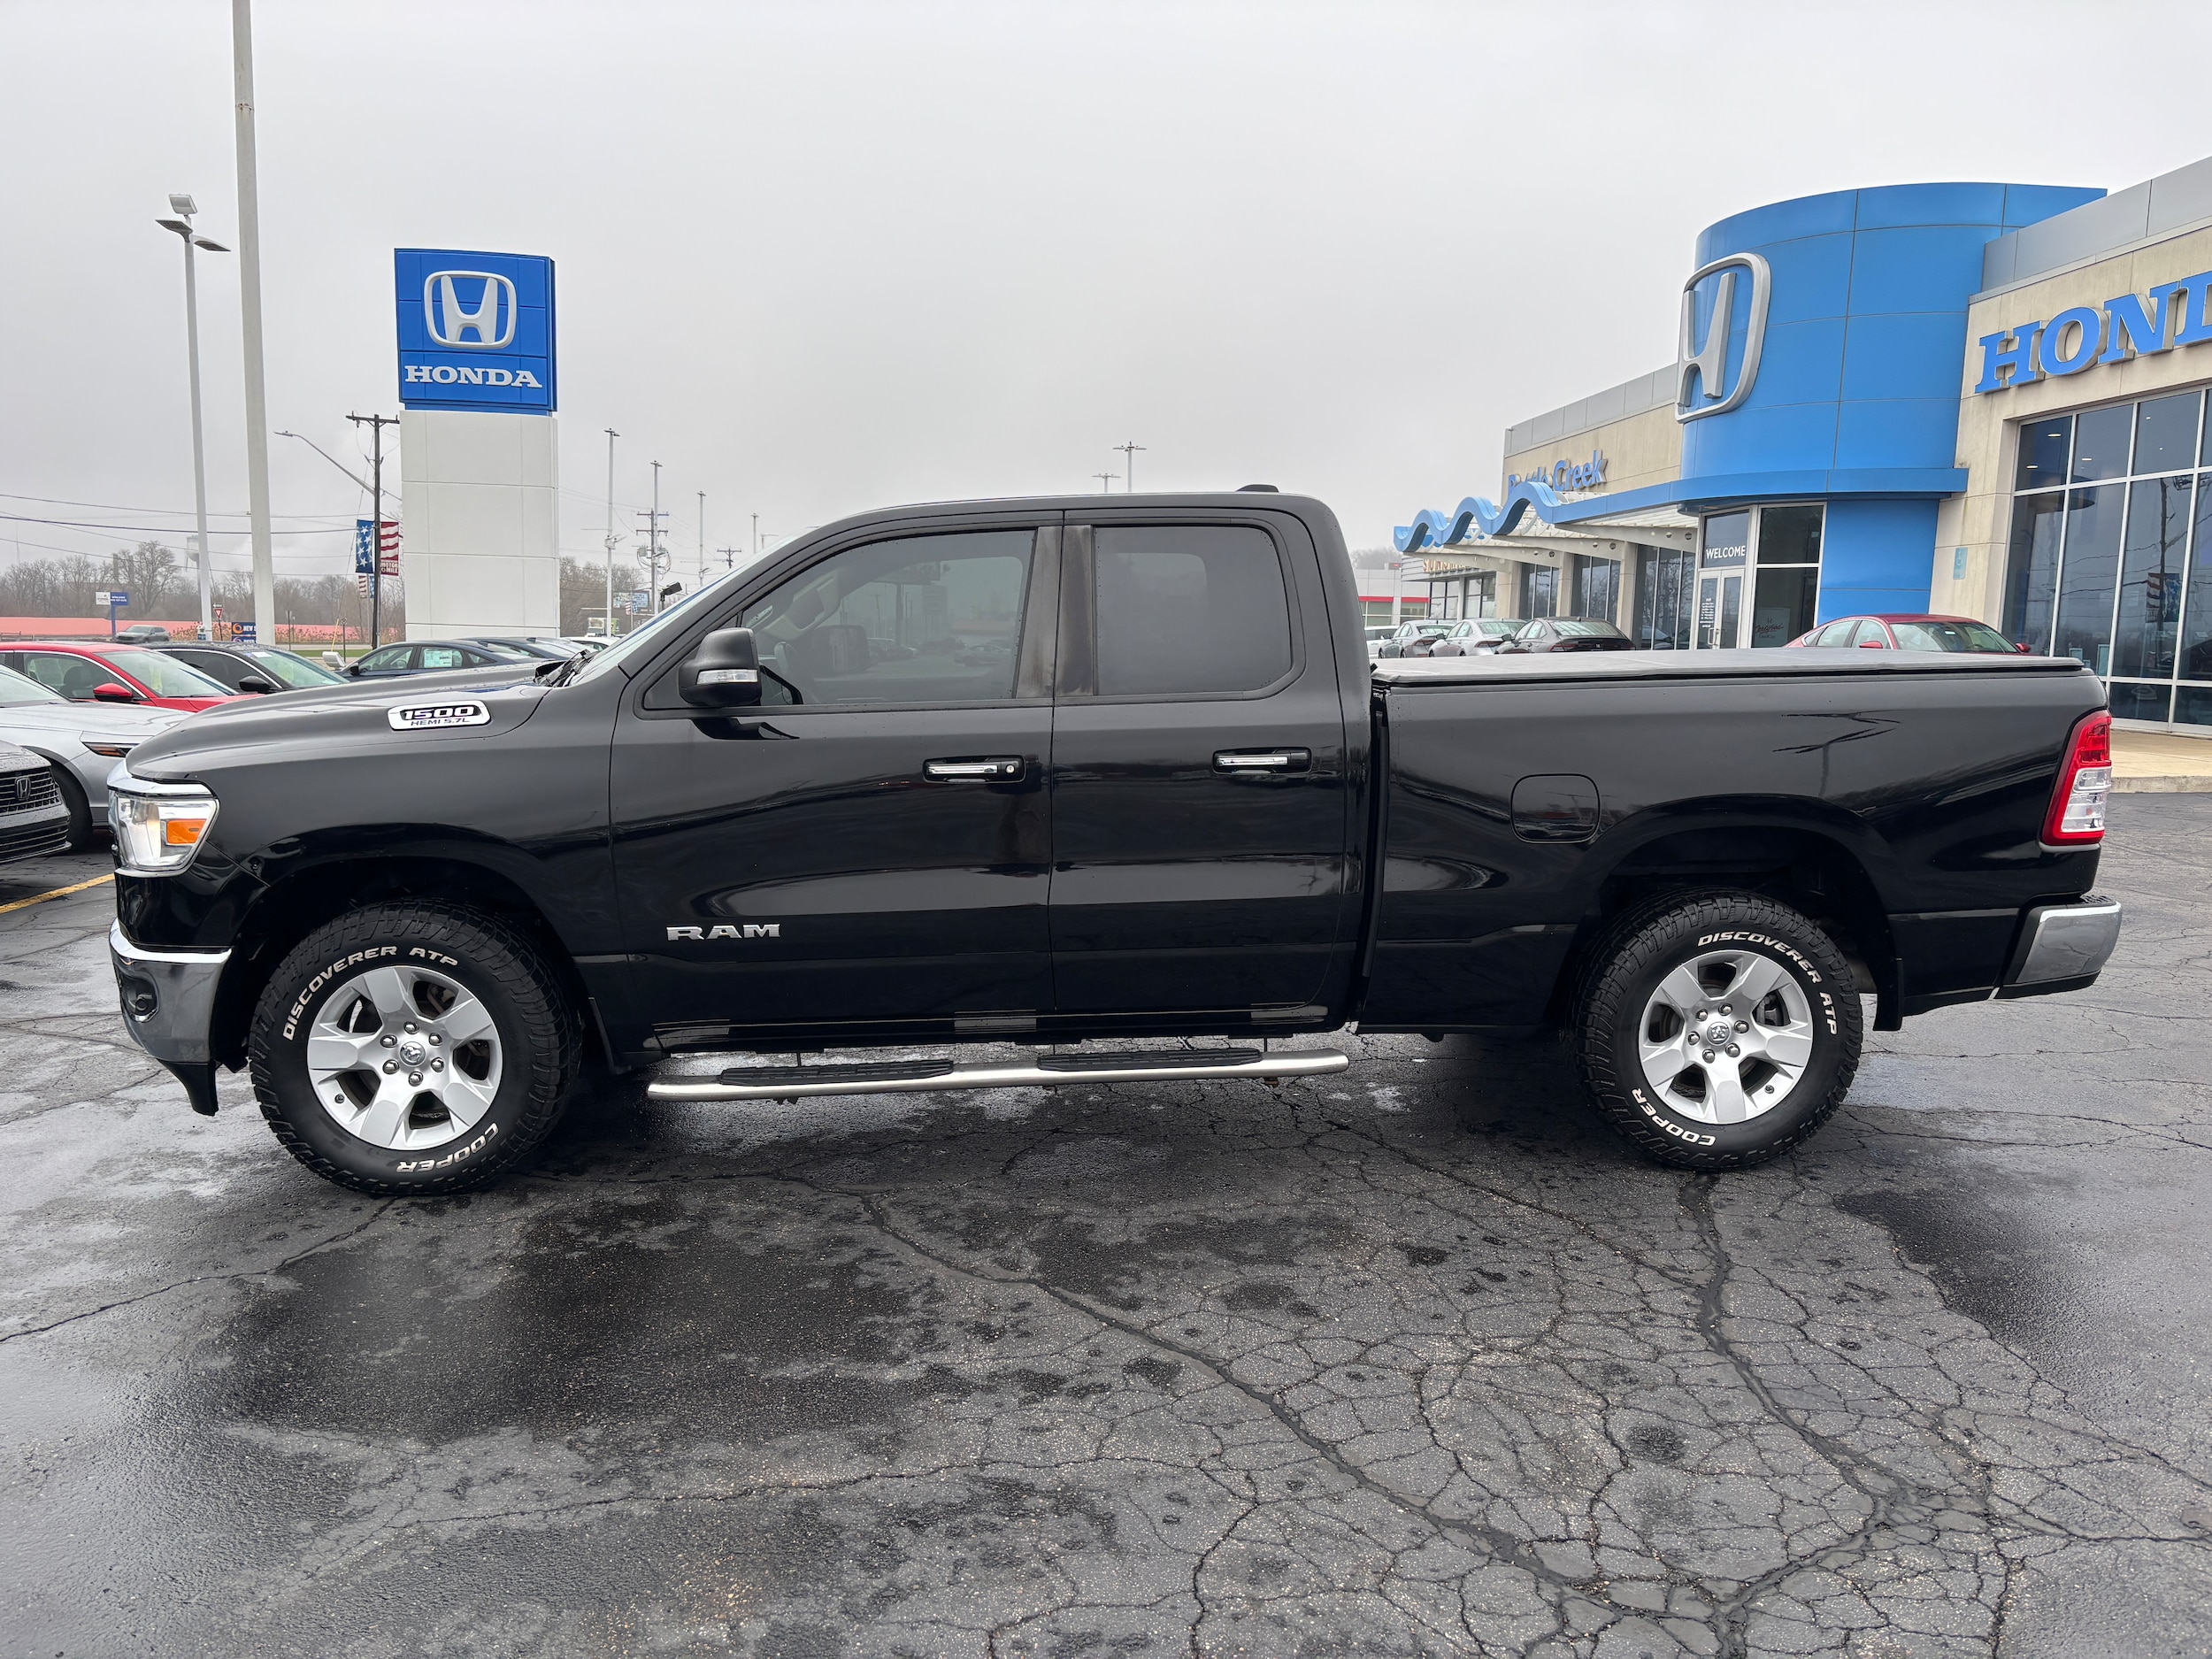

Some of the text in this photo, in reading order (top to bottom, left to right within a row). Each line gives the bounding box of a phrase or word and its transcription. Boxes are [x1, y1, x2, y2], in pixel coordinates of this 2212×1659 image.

[404, 365, 542, 388] HONDA
[1553, 449, 1607, 491] Creek
[1706, 545, 1746, 559] WELCOME
[405, 706, 474, 720] 1500
[666, 924, 780, 941] RAM
[282, 946, 458, 1041] DISCOVERER ATP
[1697, 931, 1838, 1035] DISCOVERER ATP
[1632, 1087, 1717, 1146] COOPER
[396, 1122, 499, 1173] COOPER
